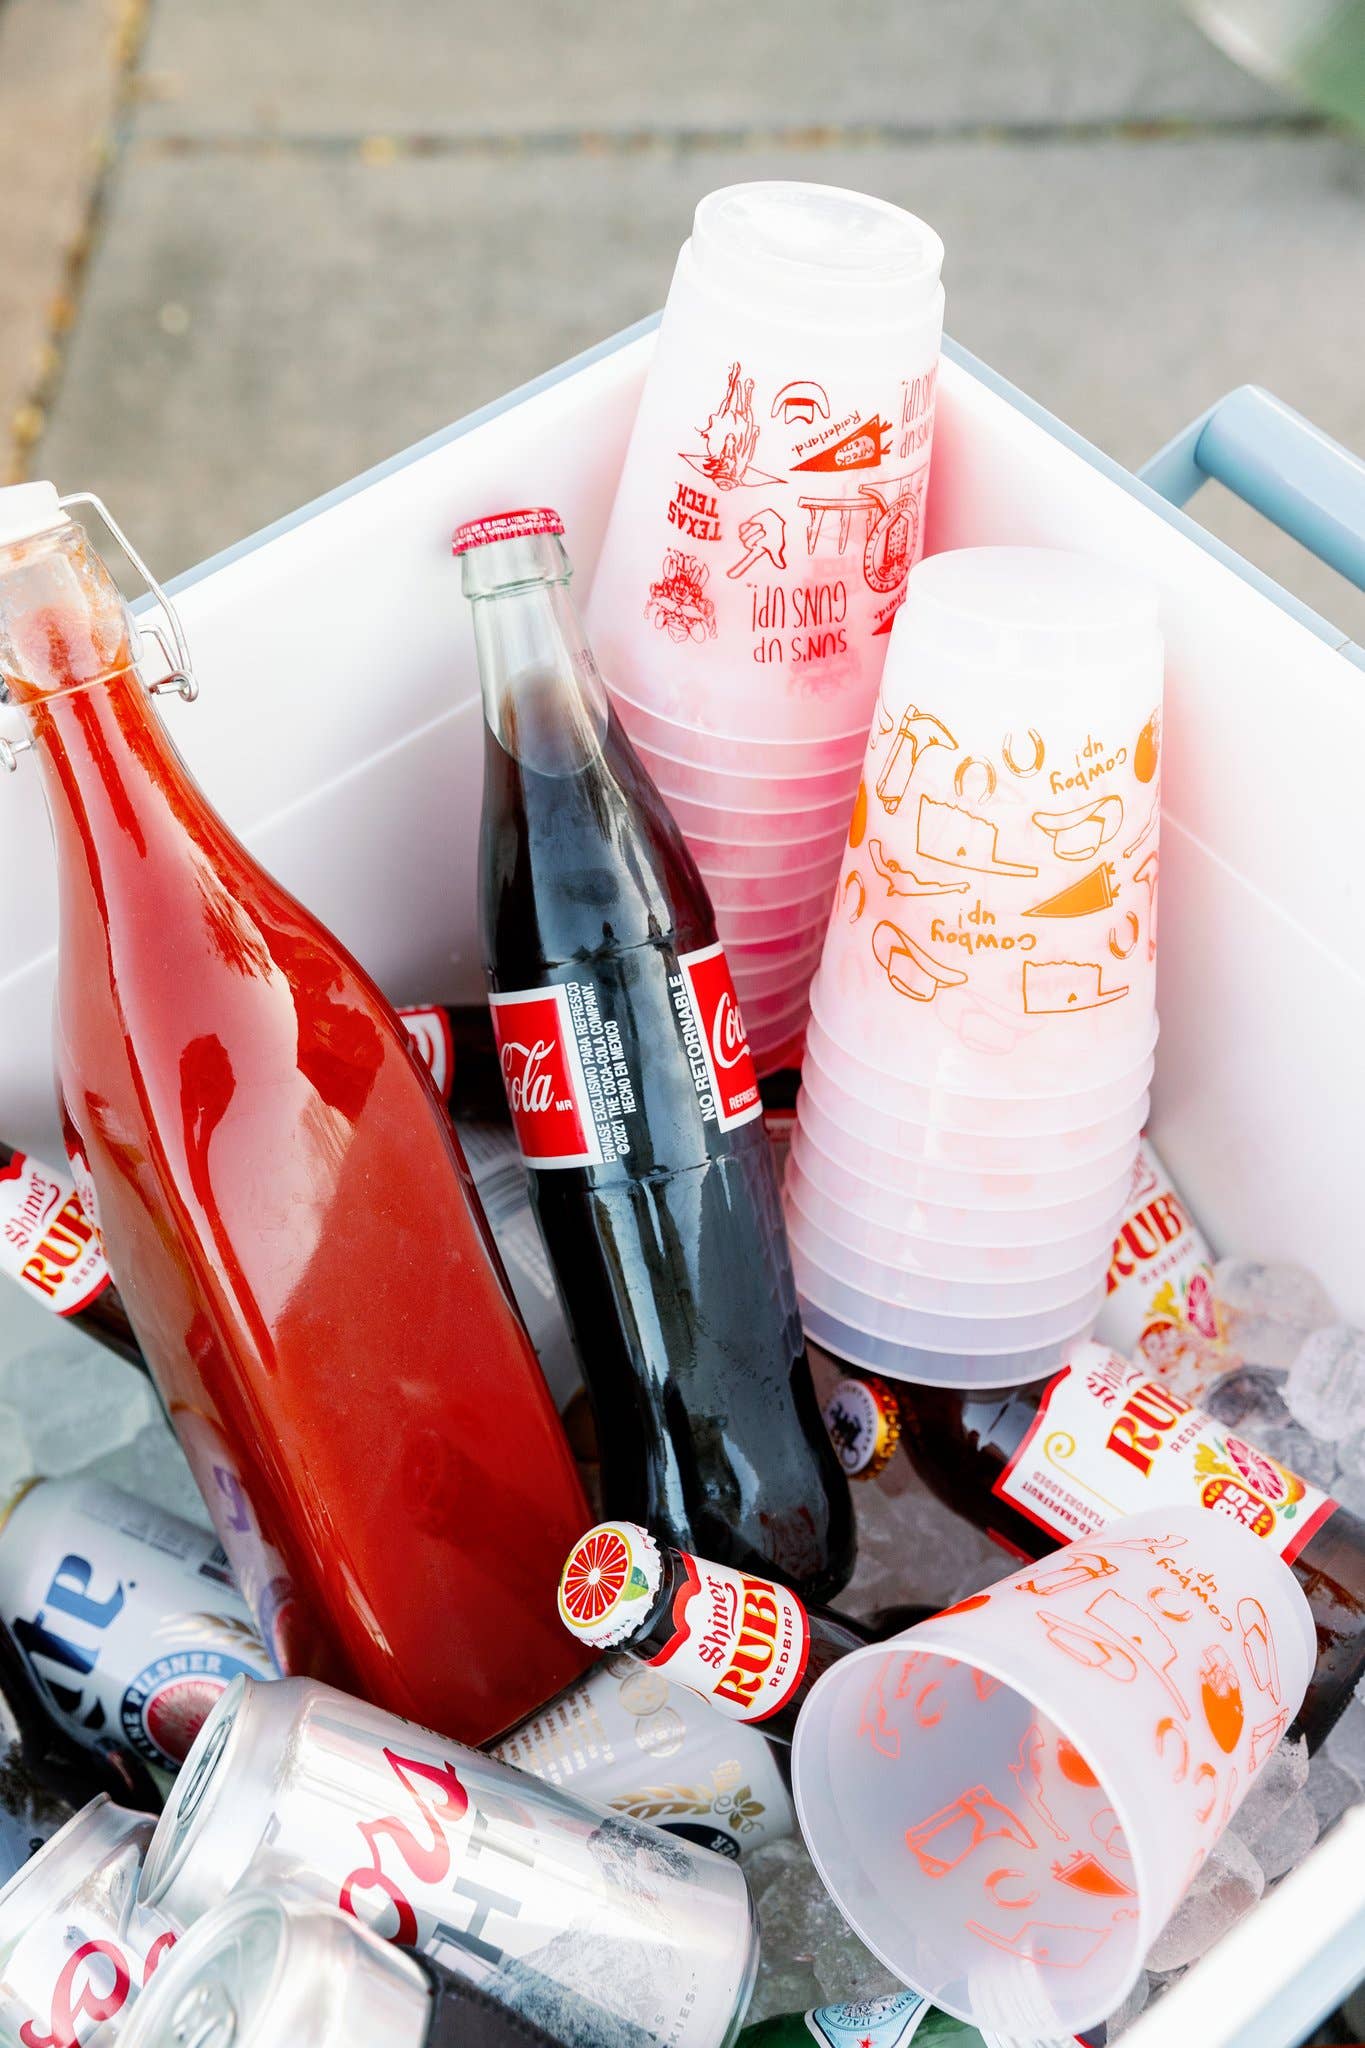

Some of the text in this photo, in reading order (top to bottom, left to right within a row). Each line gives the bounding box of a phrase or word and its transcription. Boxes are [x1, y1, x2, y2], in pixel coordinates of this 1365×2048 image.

[837, 443, 877, 469] wreck
[667, 500, 723, 542] TEXAS
[677, 481, 719, 517] TECH
[750, 583, 785, 633] UP!
[792, 585, 847, 629] GUNS
[753, 628, 848, 664] SUN'S UP
[566, 981, 618, 1164] ENVASE EXCLUSIVO PARA REFRESCO
[581, 982, 631, 1155] ©2021 THE COCA-COLA COMPANY.
[603, 1020, 637, 1114] HECHO EN MEXICO
[668, 973, 717, 1122] NO RETORNABLE
[555, 1099, 574, 1112] MR
[5, 1172, 60, 1251] Shiner
[698, 1575, 738, 1670] Shiner
[768, 1605, 793, 1688] REDBIRD
[125, 1655, 222, 1712] PILSNER
